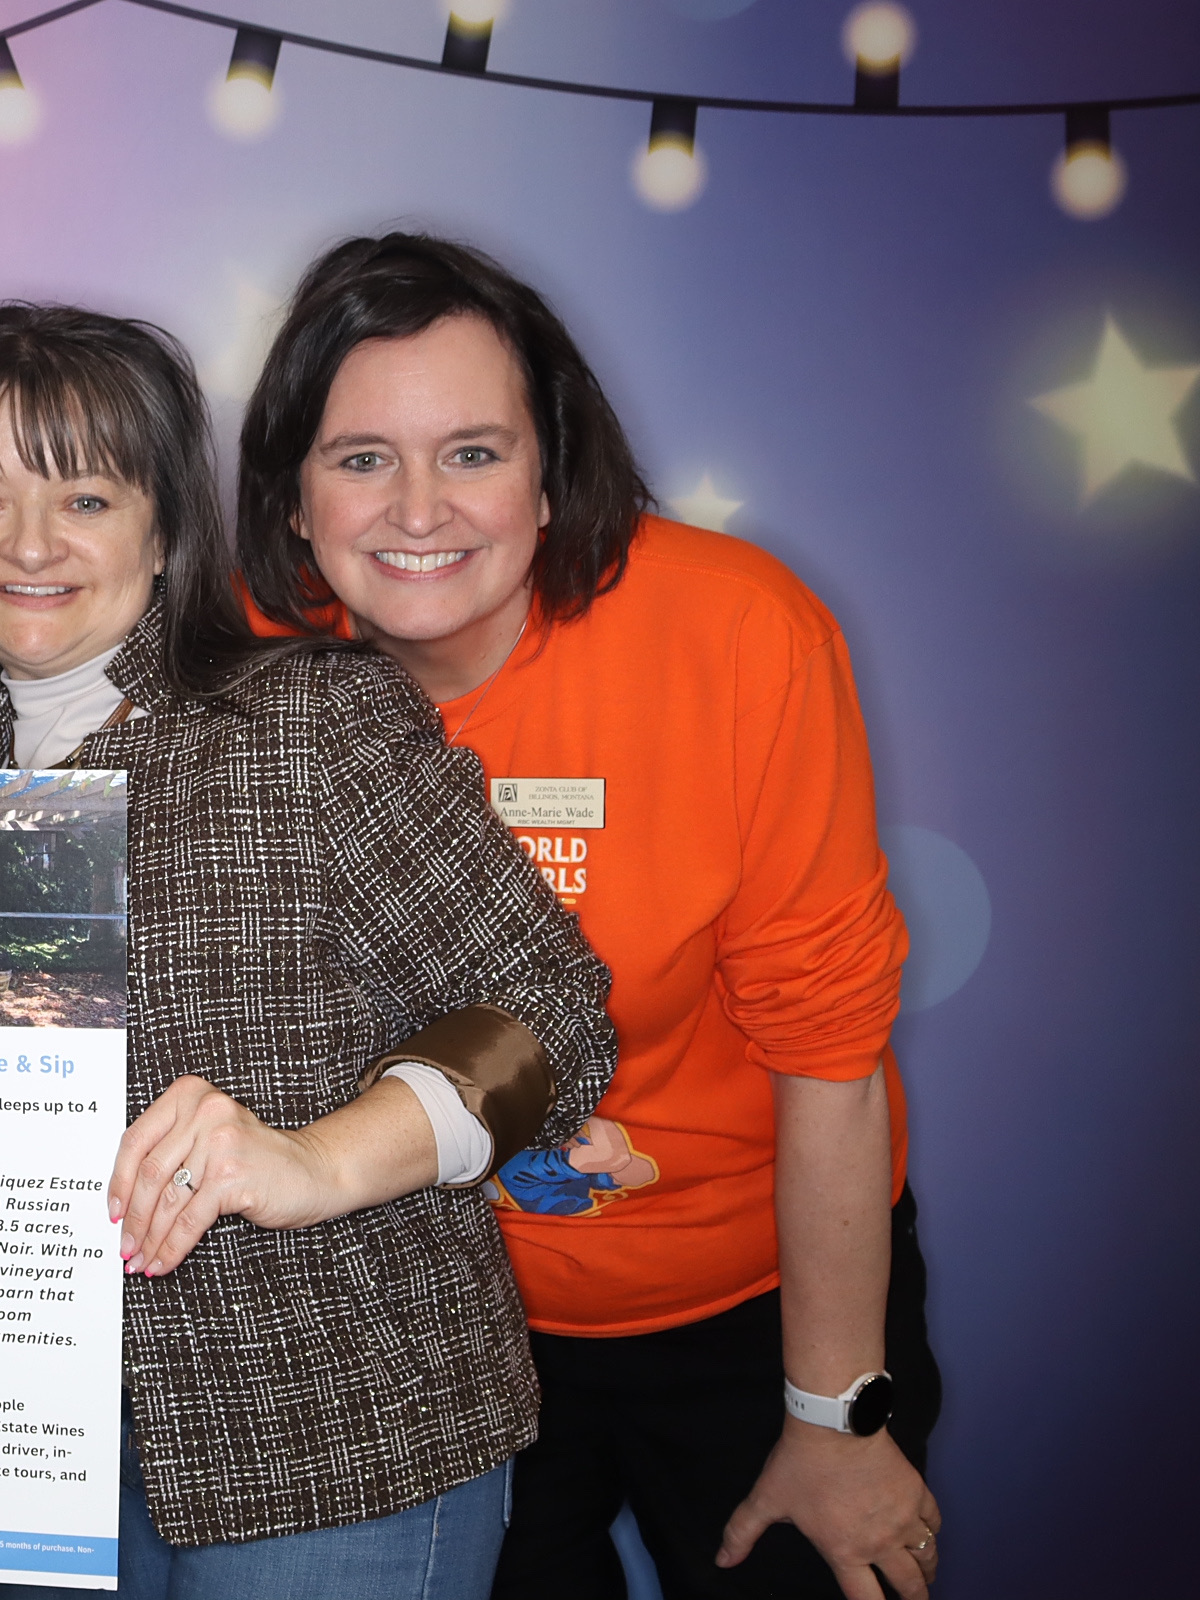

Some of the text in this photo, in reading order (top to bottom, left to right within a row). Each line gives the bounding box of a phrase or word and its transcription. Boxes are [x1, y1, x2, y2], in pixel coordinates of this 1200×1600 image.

[500, 806, 594, 818] Anne-Marie Wade
[516, 835, 588, 863] ORLD
[541, 867, 587, 894] RLS
[16, 1054, 32, 1073] &
[40, 1054, 74, 1079] Sip
[44, 1102, 64, 1115] up
[68, 1101, 84, 1113] to
[88, 1101, 98, 1113] 4
[49, 1177, 103, 1191] Estate
[5, 1197, 70, 1212] Russian
[24, 1223, 73, 1238] acres,
[0, 1263, 74, 1281] vineyard
[39, 1287, 75, 1302] that
[41, 1423, 85, 1437] Wines
[2, 1443, 49, 1460] driver,
[53, 1445, 72, 1458] in-
[5, 1542, 32, 1550] months
[32, 1542, 41, 1550] of
[41, 1544, 76, 1553] purchase.
[77, 1545, 95, 1553] Non-
